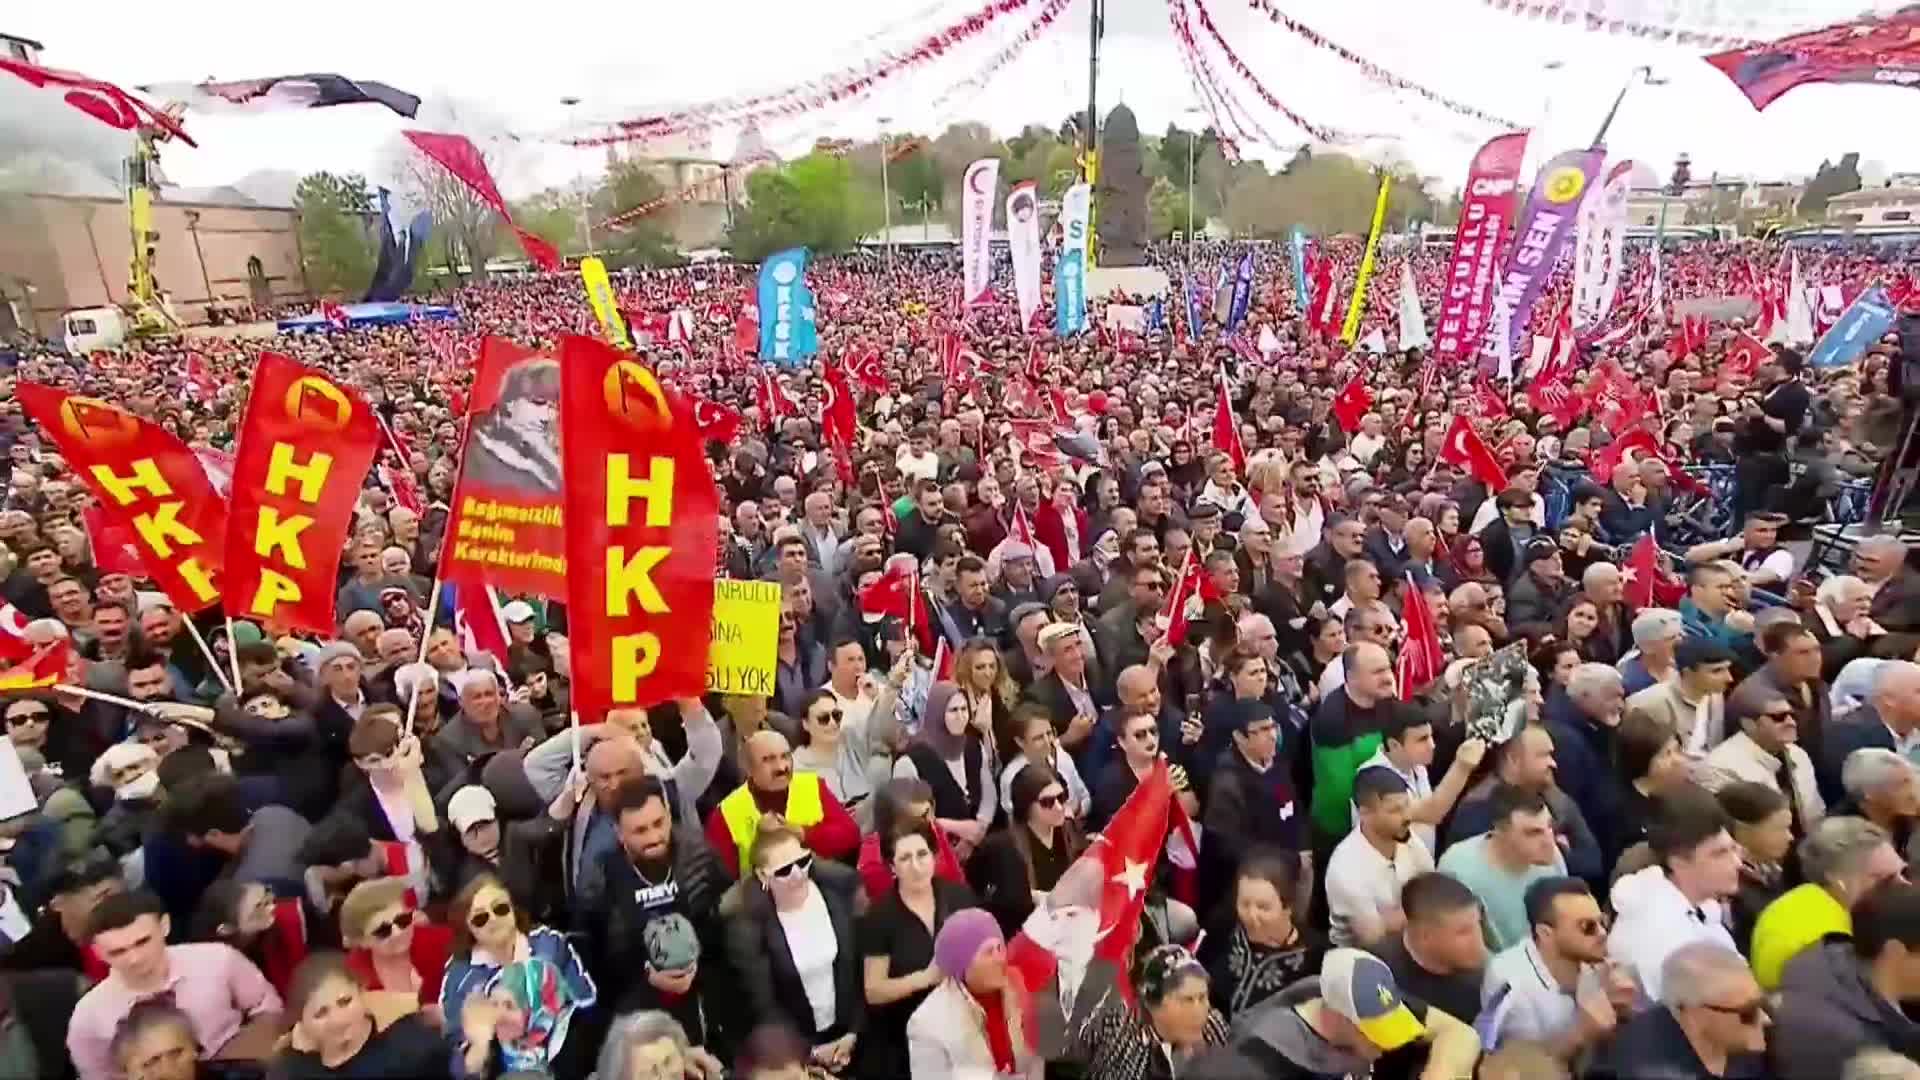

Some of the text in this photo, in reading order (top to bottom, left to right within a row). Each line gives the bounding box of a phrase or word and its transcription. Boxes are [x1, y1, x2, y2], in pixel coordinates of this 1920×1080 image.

[1517, 210, 1563, 268] SEN
[1439, 203, 1486, 351] SELÇUKLU
[251, 441, 334, 617] HKP
[459, 520, 514, 544] Benim
[454, 541, 567, 576] Karakterimd
[606, 453, 675, 703] HKP
[737, 665, 772, 693] YOK
